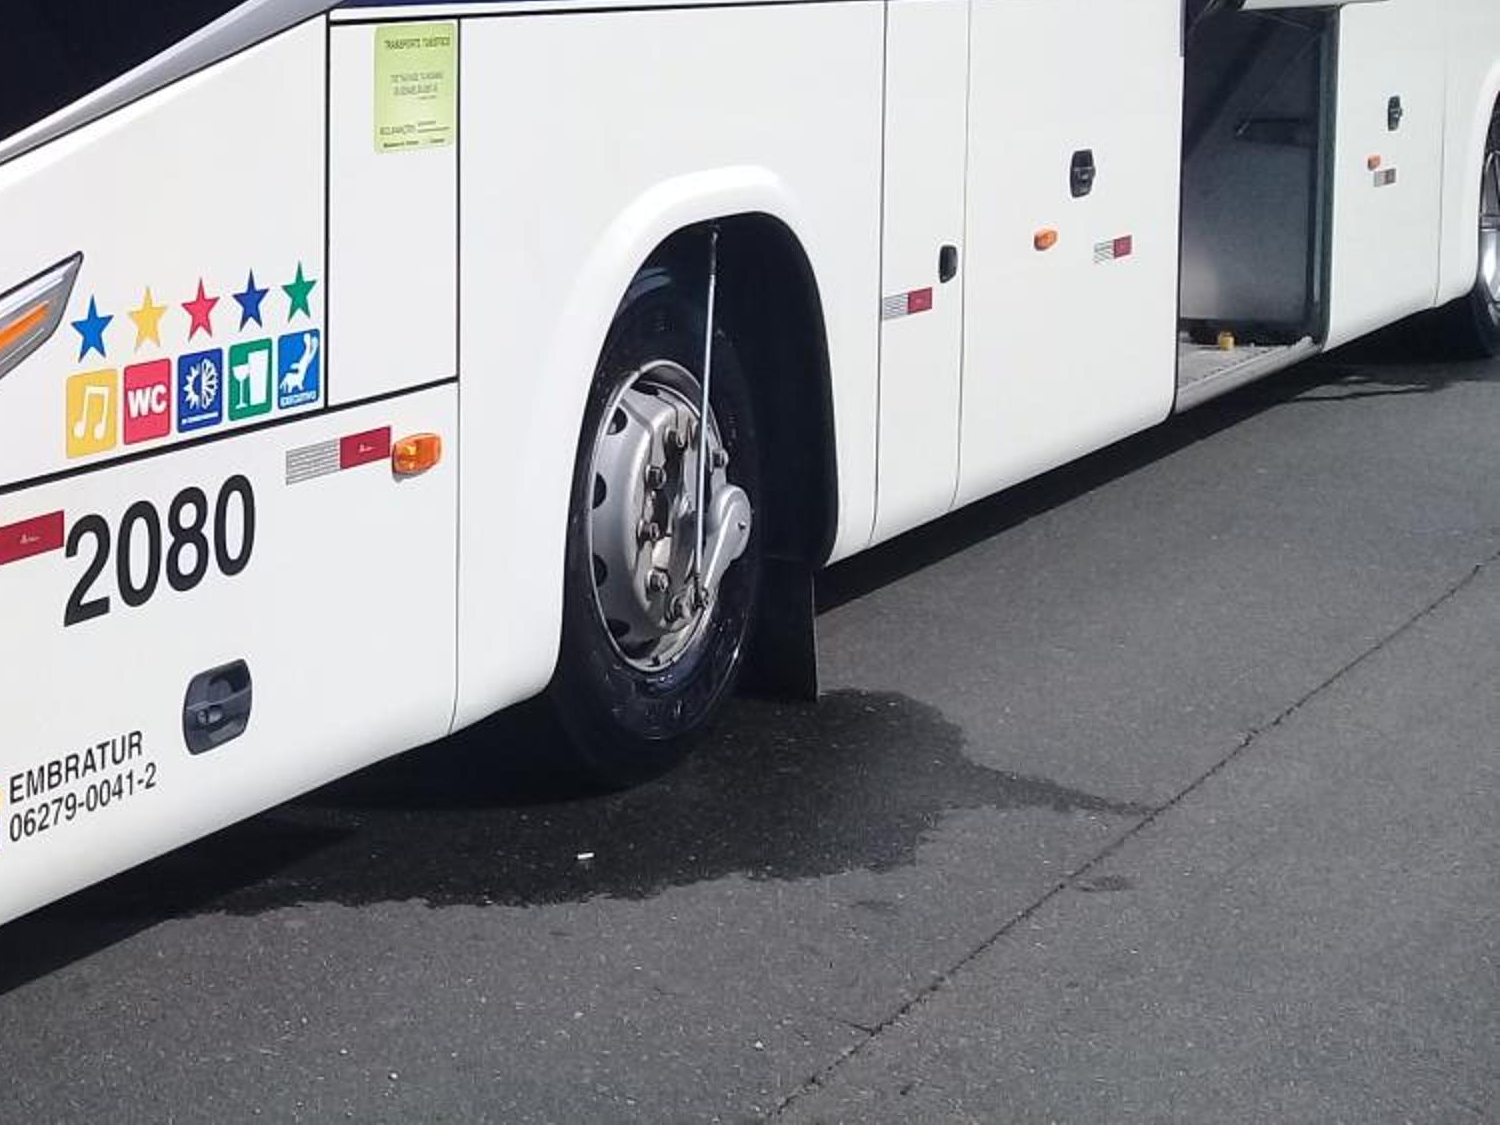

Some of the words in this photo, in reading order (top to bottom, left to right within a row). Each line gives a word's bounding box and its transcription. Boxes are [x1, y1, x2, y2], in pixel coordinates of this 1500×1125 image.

[127, 384, 168, 418] WC
[64, 474, 256, 627] 2080
[9, 730, 143, 804] EMBRATUR
[10, 761, 157, 843] 06279-0041-2
